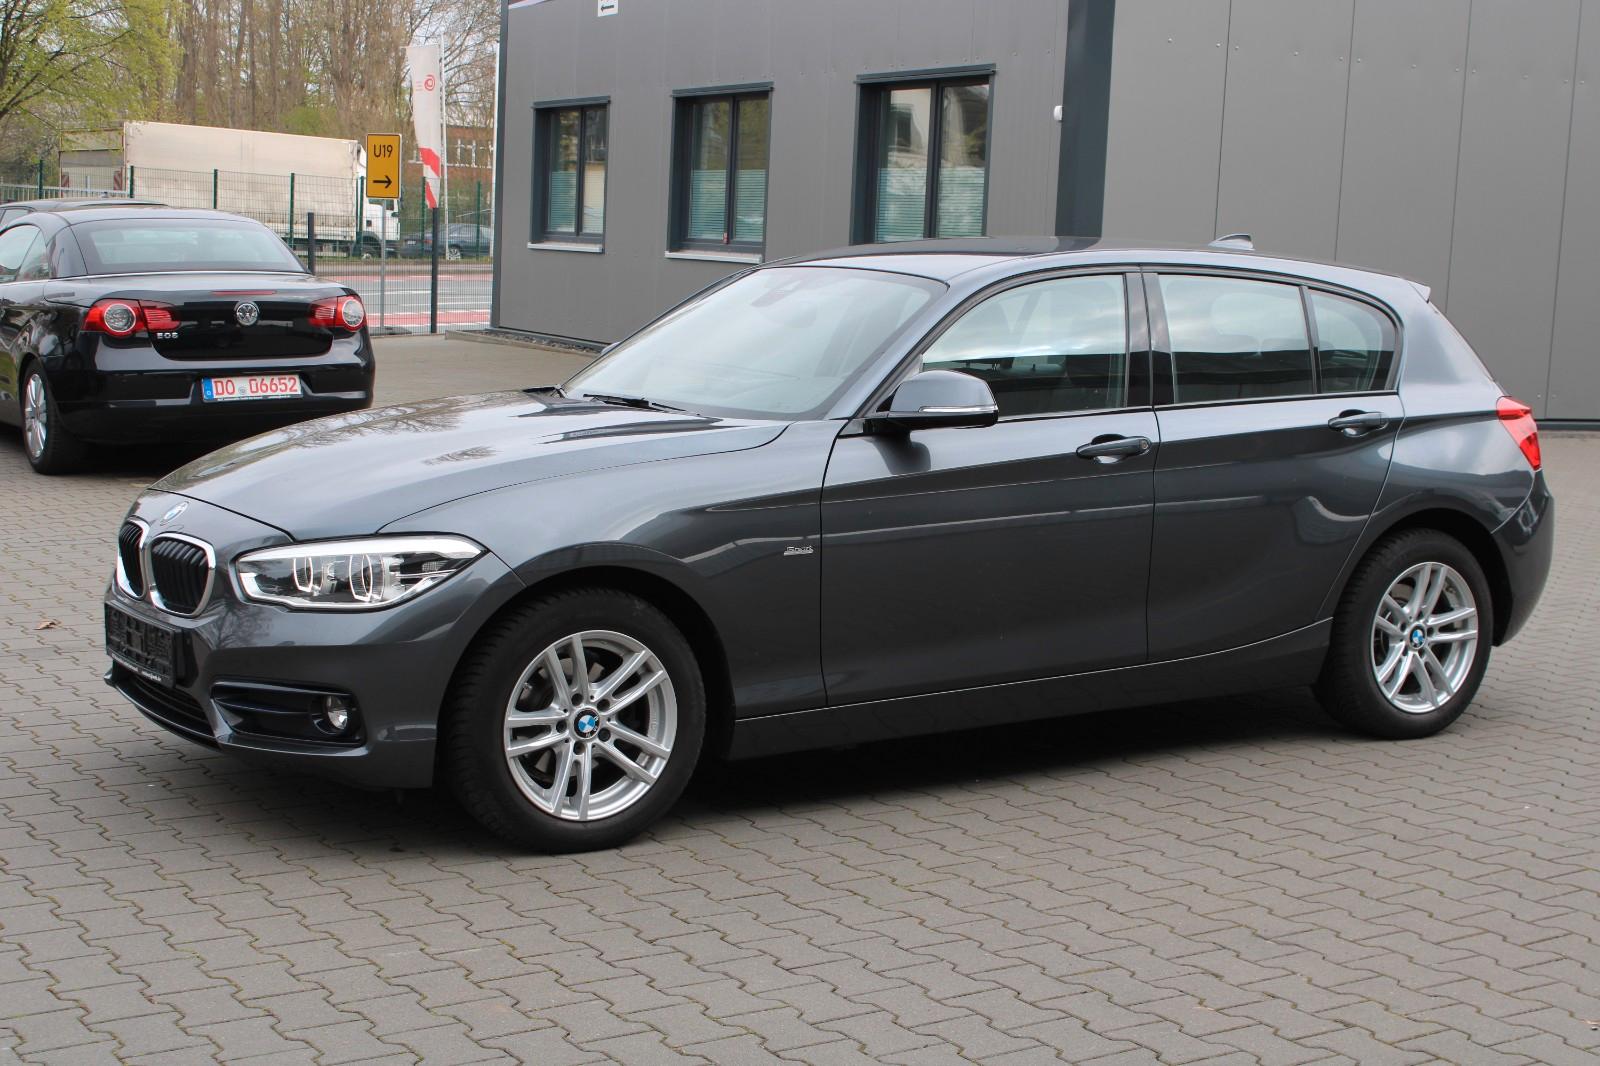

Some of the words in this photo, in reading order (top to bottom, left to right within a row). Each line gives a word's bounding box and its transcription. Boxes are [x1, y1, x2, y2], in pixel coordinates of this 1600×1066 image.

[373, 144, 393, 158] U19
[213, 379, 236, 396] DO
[248, 376, 298, 394] 06652
